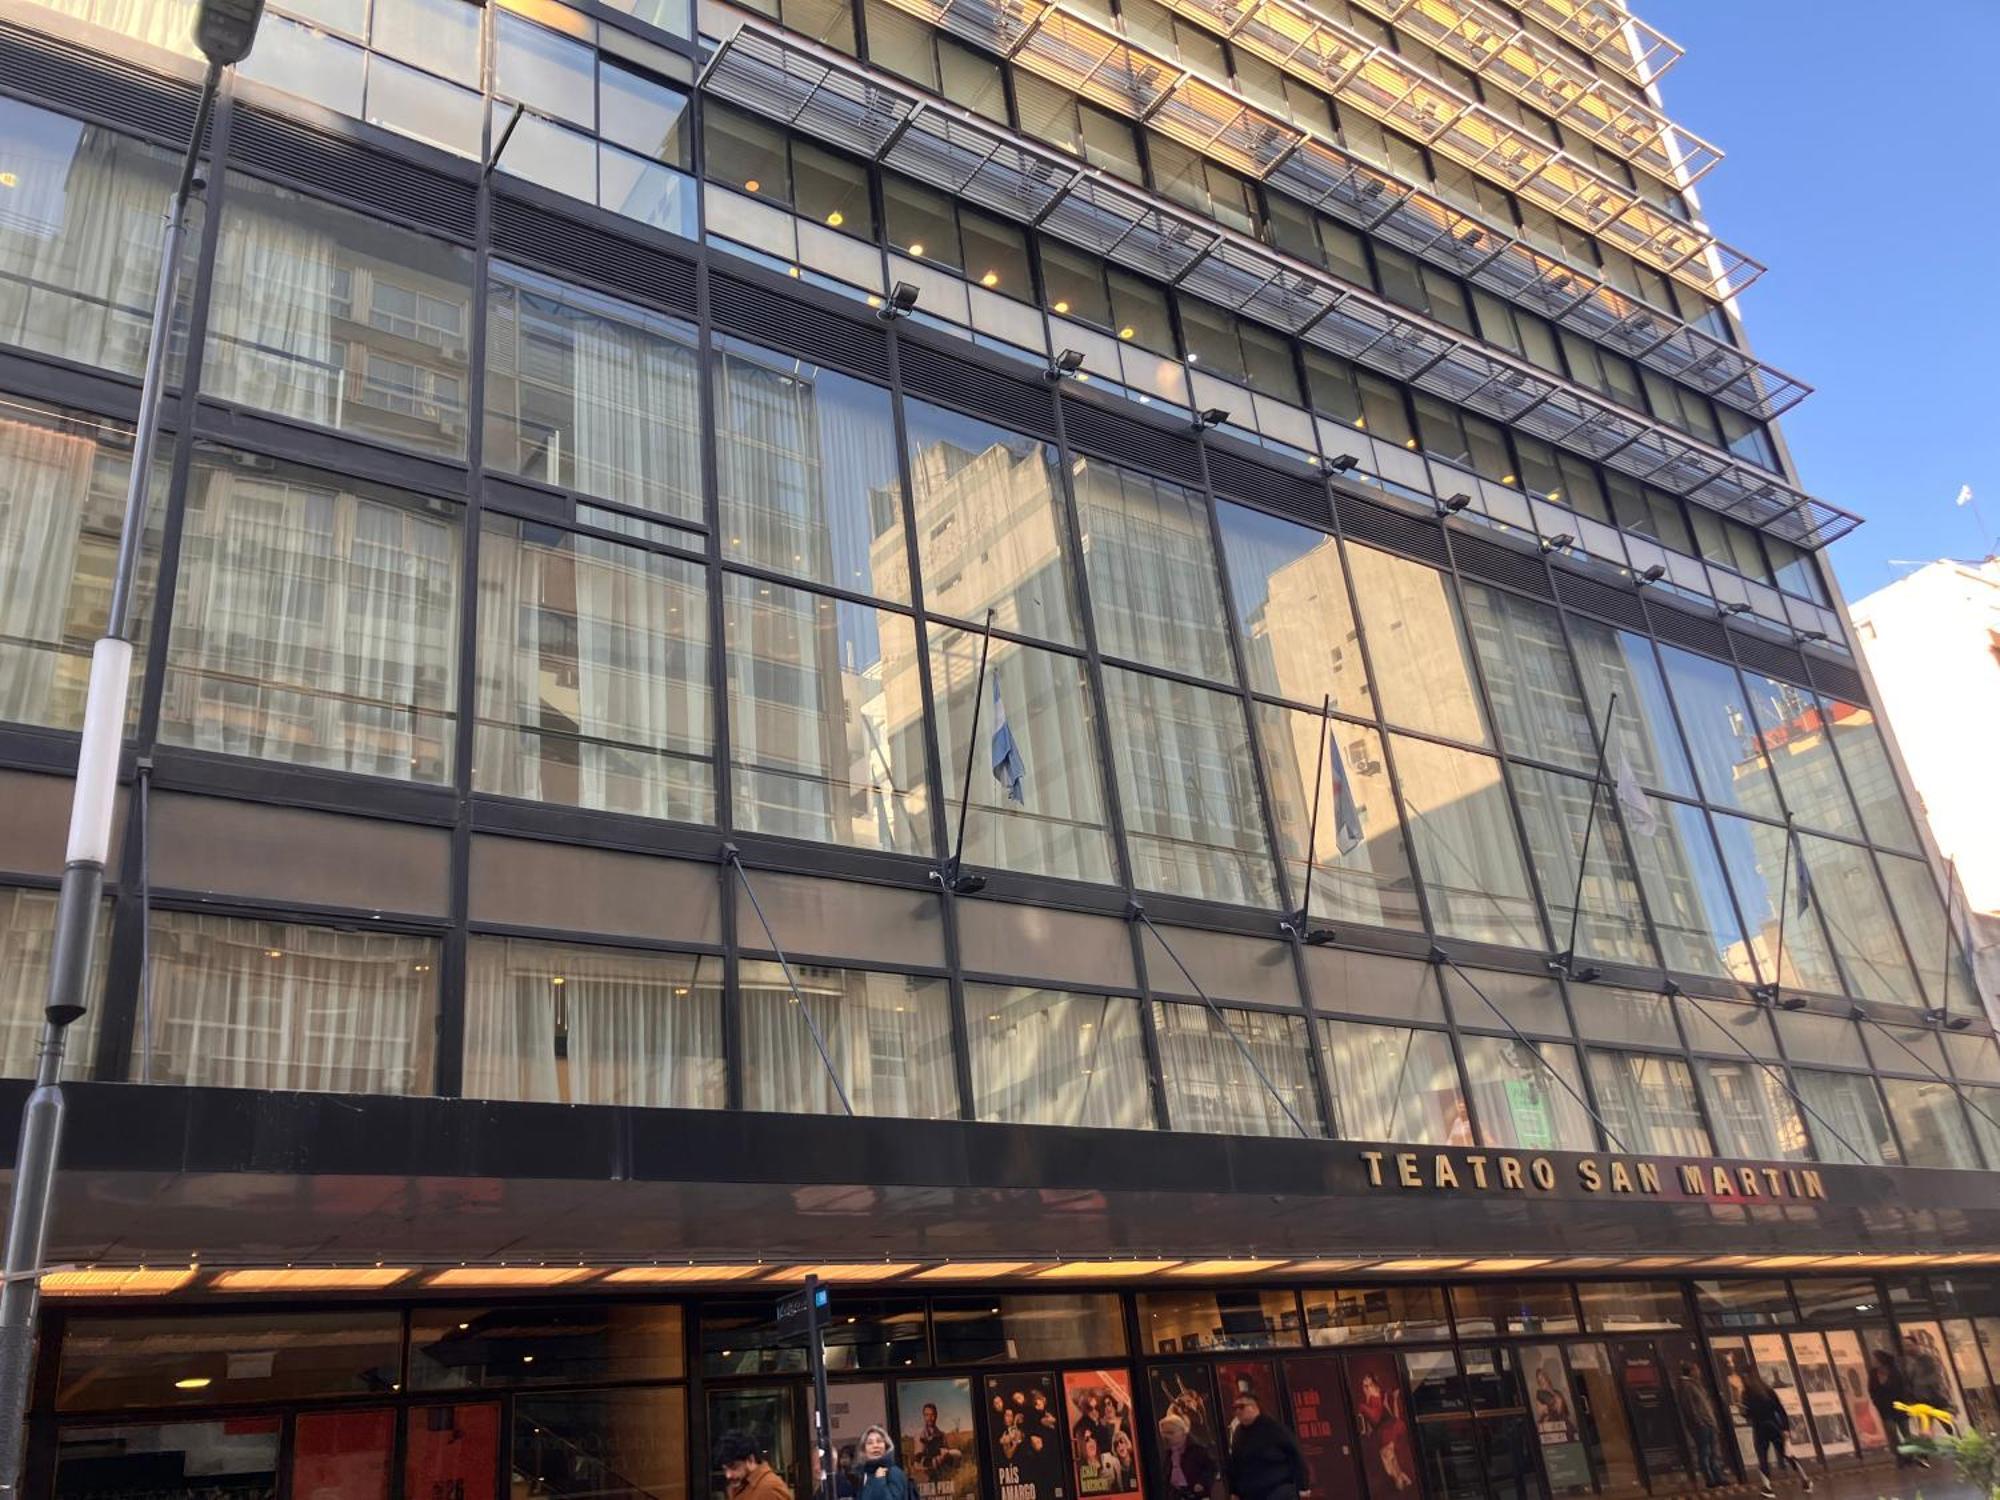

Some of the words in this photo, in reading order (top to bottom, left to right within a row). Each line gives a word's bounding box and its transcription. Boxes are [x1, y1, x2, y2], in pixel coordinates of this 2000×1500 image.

[1361, 1151, 1554, 1190] TEATRO
[1578, 1159, 1662, 1193] SAN
[1678, 1165, 1826, 1200] MARTIN
[998, 1463, 1020, 1485] PAÍS
